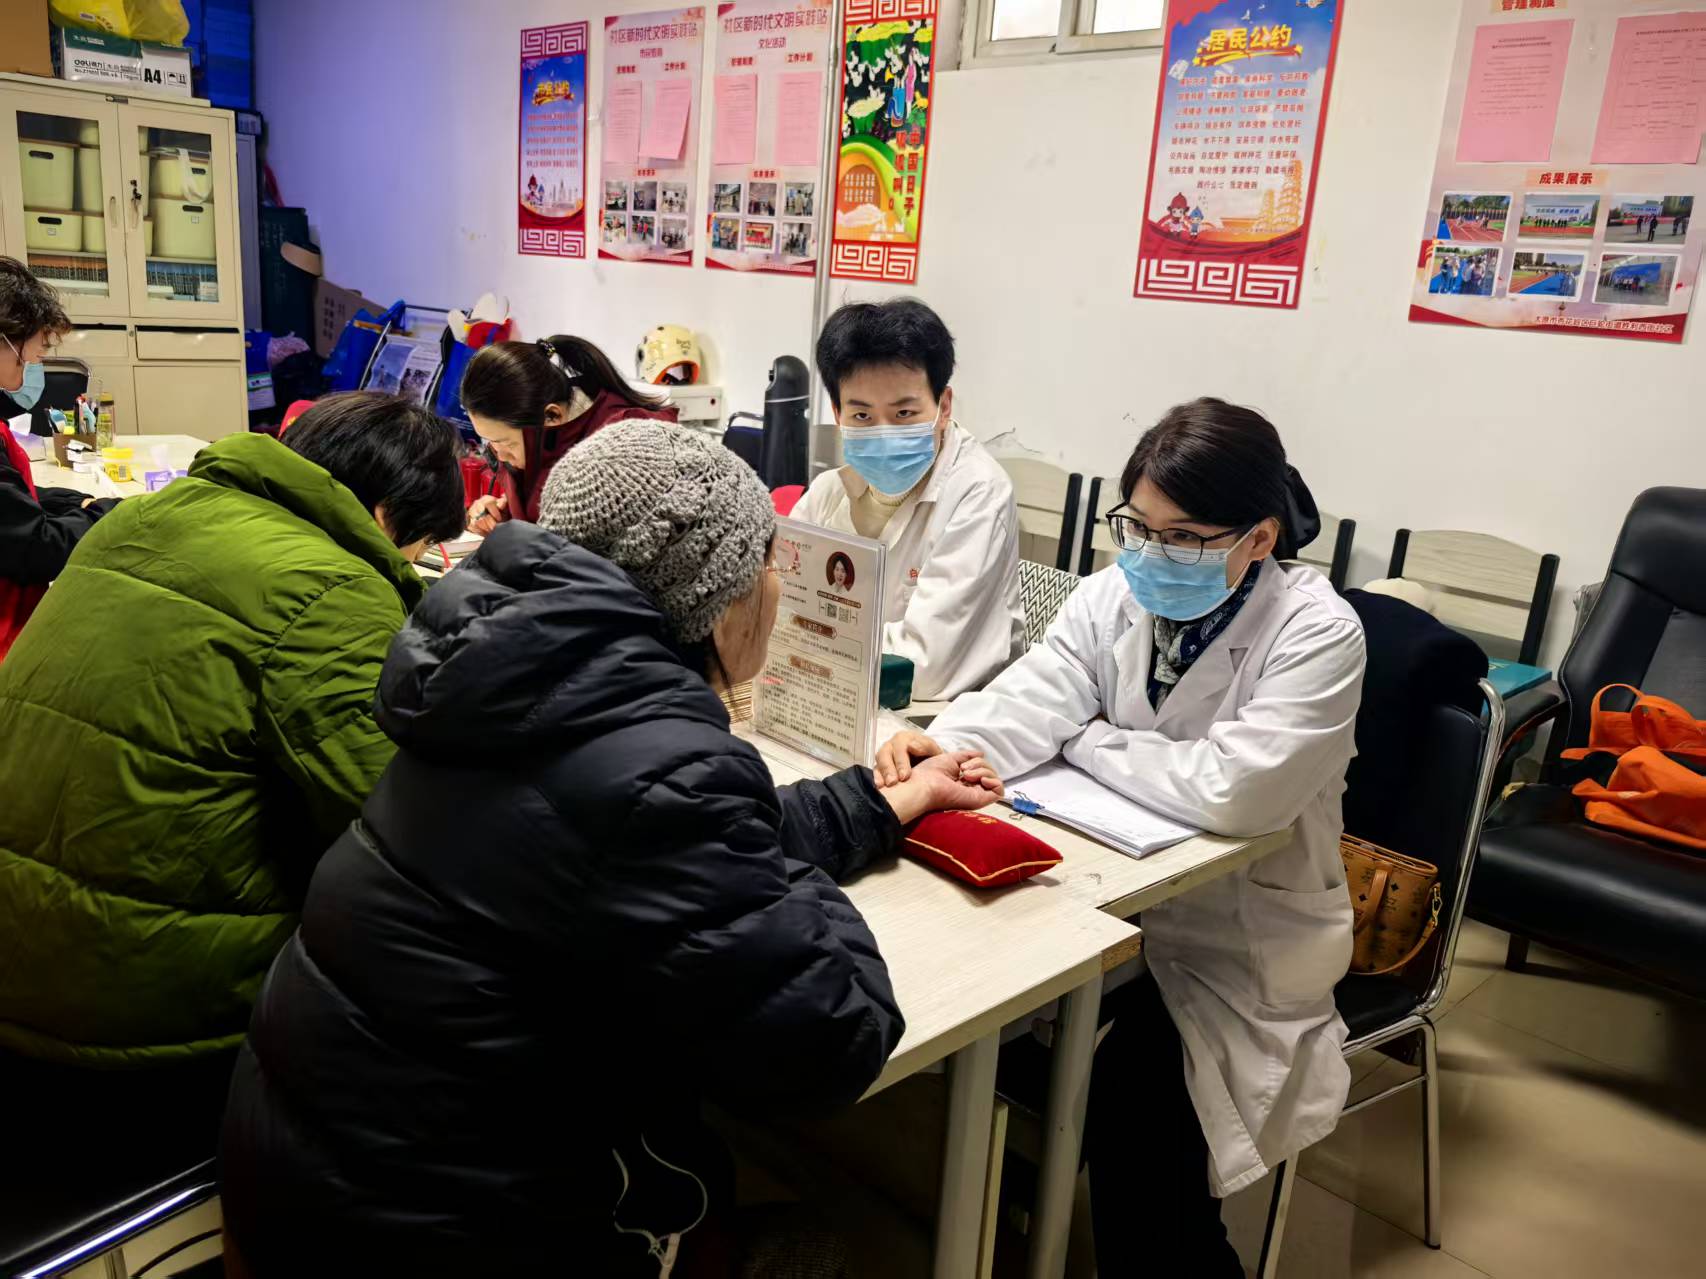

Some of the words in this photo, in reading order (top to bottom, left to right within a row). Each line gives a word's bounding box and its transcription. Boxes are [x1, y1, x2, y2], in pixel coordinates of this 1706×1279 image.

[724, 9, 828, 33] 社区新时代文明实践站
[610, 22, 698, 43] 社区新时代文明实践站
[1206, 24, 1293, 51] 居民公约
[144, 68, 161, 84] A4
[1539, 172, 1593, 185] 成果展示
